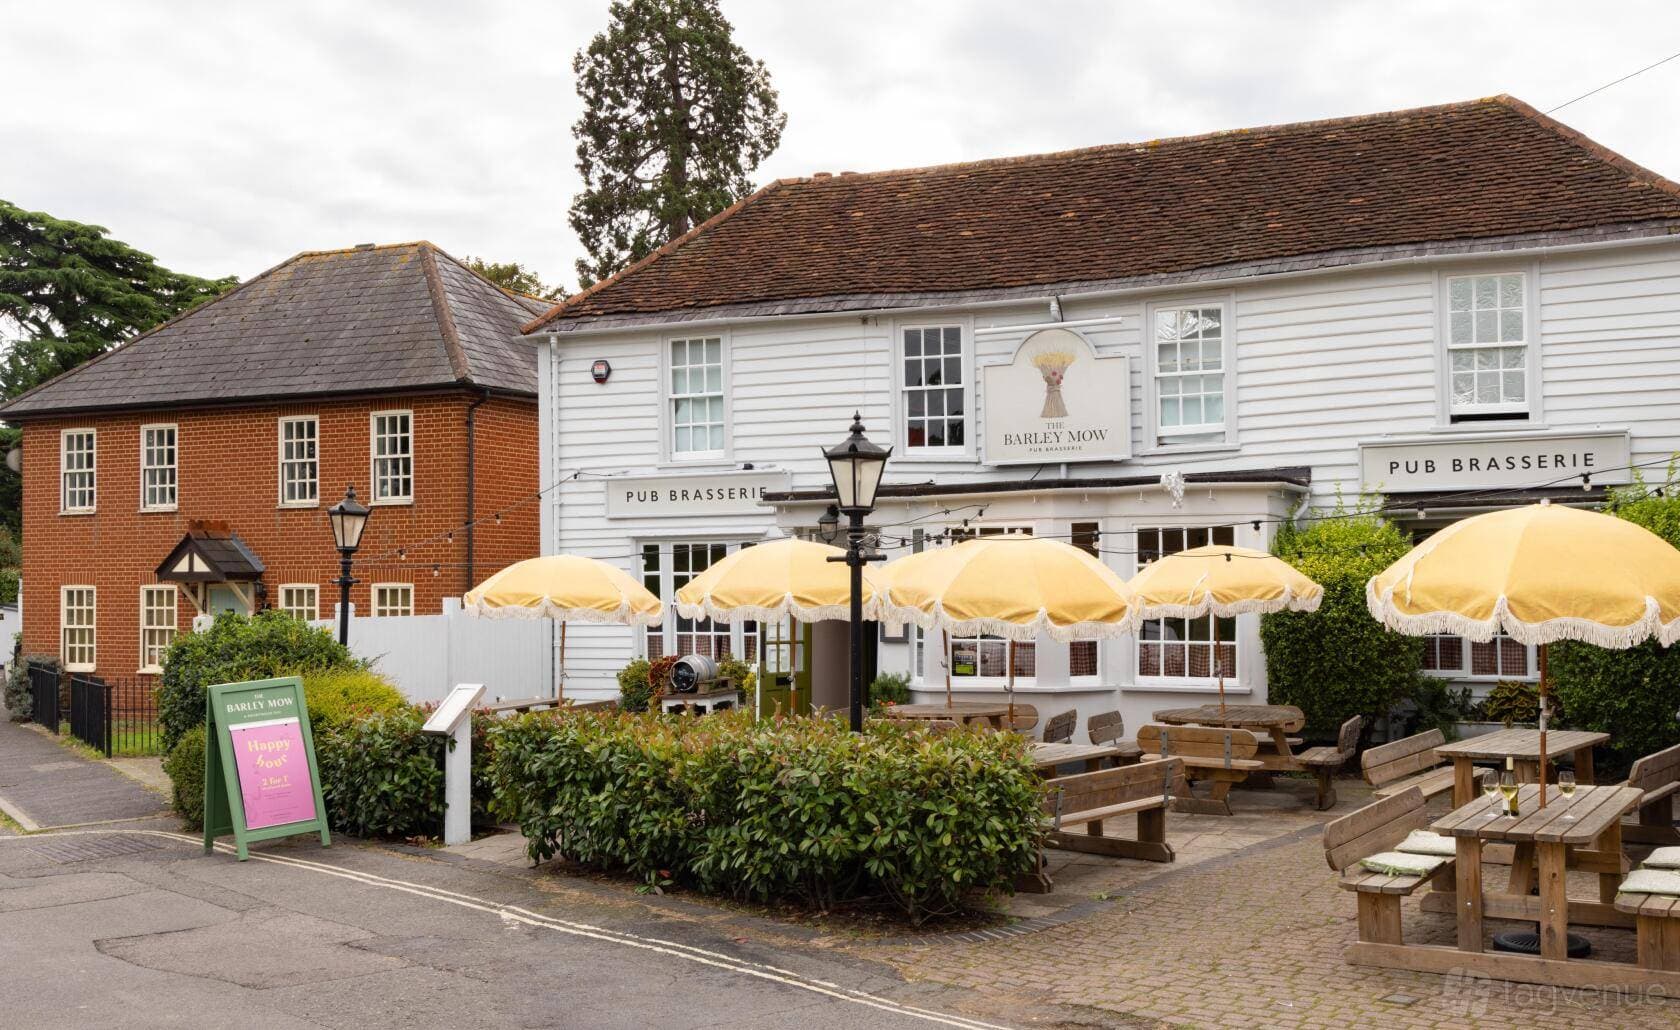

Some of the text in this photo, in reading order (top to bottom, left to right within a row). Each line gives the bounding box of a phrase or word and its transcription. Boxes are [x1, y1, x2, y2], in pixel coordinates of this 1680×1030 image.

[1046, 421, 1065, 430] THE
[1004, 429, 1108, 446] BARLEY MOW
[1389, 452, 1595, 475] PUB BRASSERIE
[626, 486, 768, 503] PUB BRASSERIE
[226, 697, 293, 713] BARLEY MOW
[248, 740, 290, 753] Happy
[256, 754, 288, 769] hour
